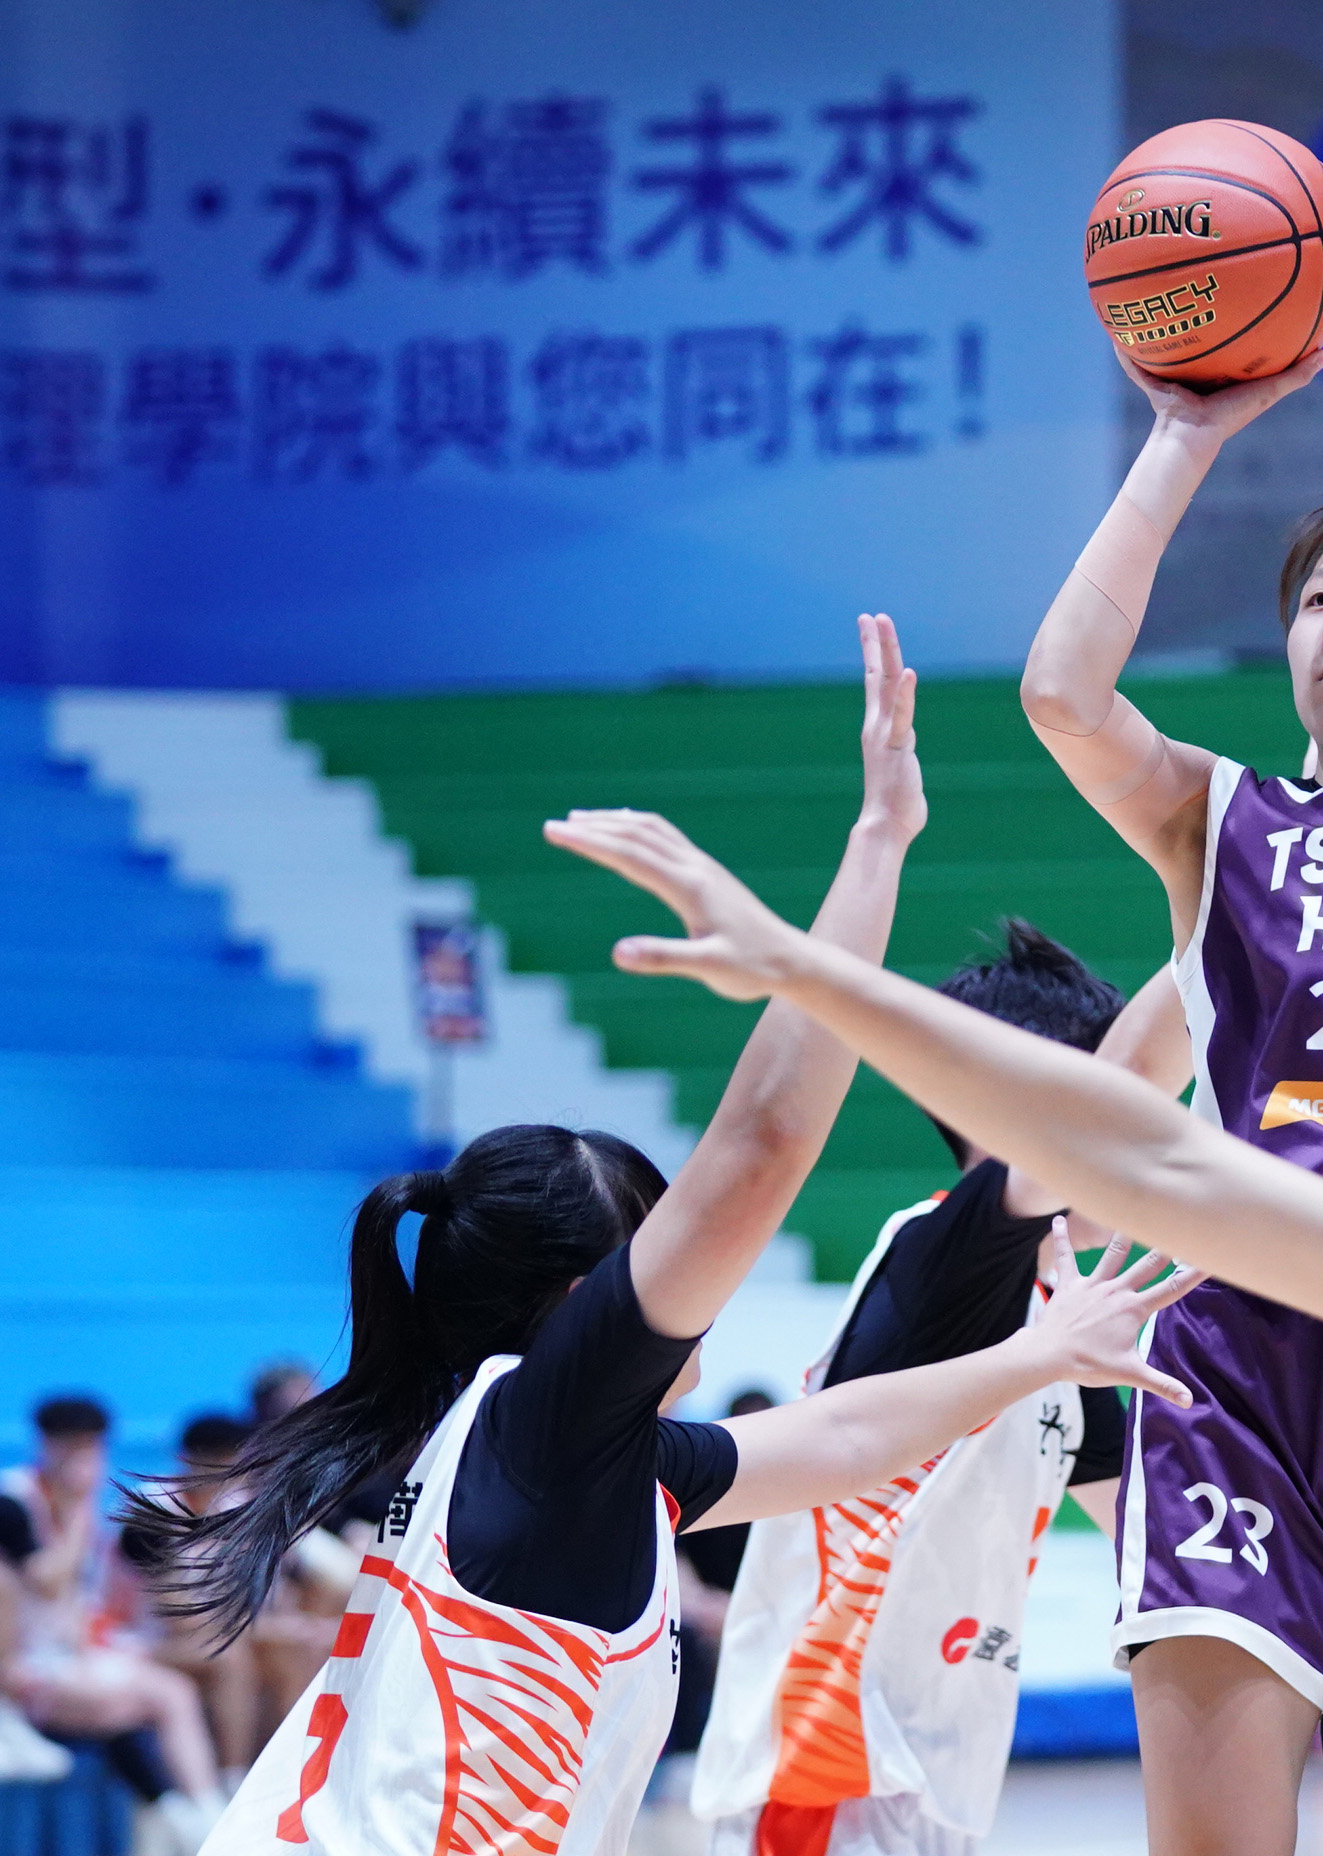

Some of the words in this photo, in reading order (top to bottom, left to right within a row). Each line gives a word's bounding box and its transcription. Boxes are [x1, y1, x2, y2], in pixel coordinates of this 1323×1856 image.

[1085, 200, 1212, 264] SPALDING
[1097, 273, 1219, 327] LEGACY
[1175, 1482, 1274, 1576] 23
